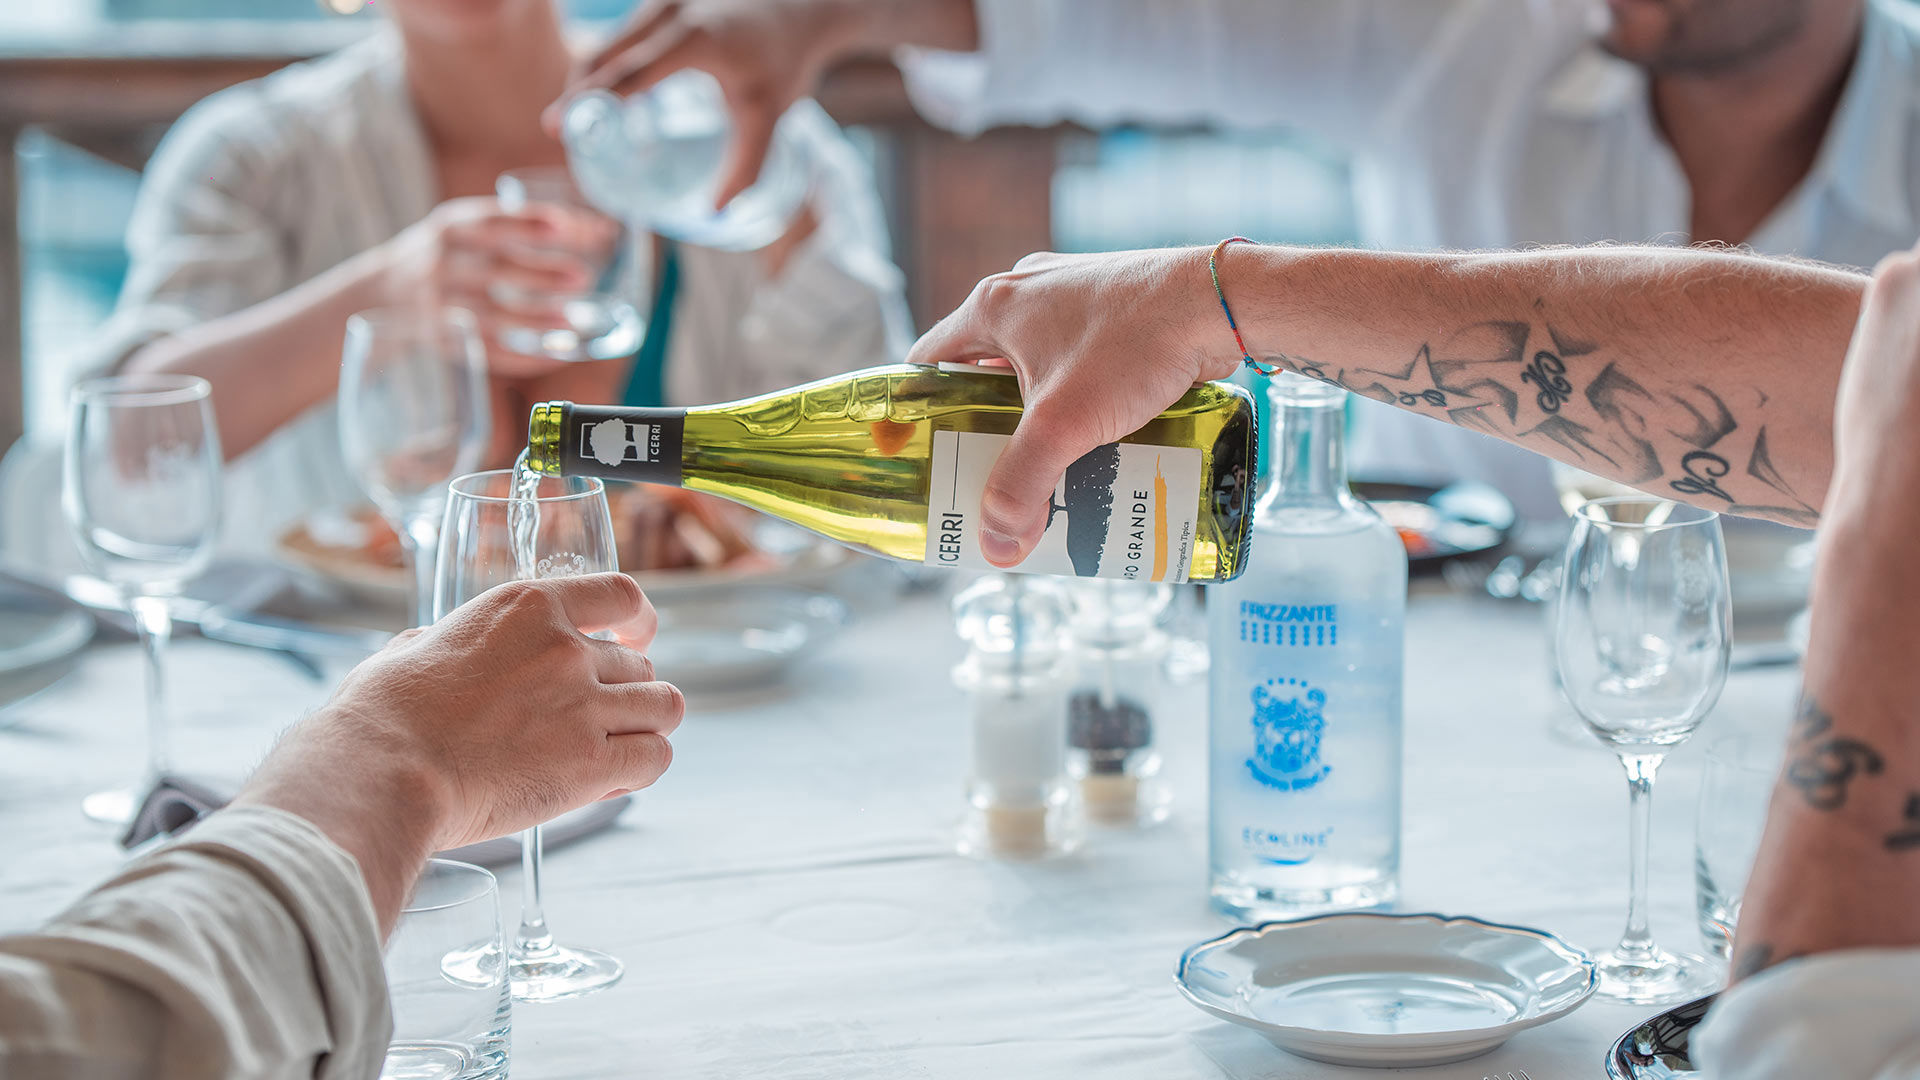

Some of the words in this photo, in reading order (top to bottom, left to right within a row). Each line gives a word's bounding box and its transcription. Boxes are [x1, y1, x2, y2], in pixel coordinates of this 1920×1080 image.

[650, 424, 661, 455] CERRI
[938, 512, 964, 562] CERRI
[1127, 490, 1148, 560] GRANDE
[1240, 600, 1337, 622] FRIZZANTE
